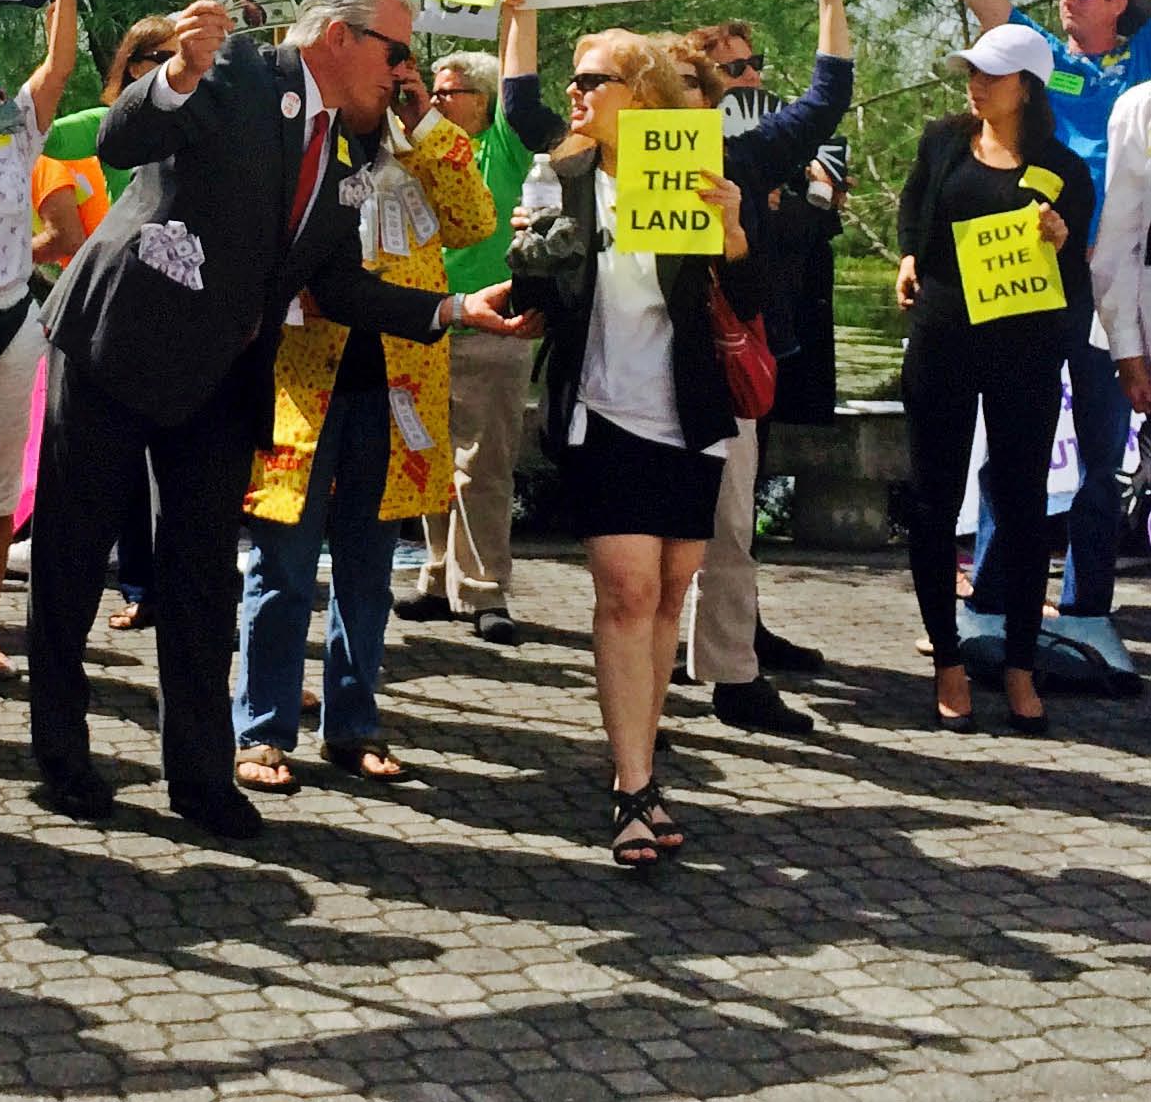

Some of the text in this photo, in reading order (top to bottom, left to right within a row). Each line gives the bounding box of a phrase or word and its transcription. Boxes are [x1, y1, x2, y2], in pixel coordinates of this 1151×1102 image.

[644, 130, 699, 151] BUY
[643, 170, 700, 191] THE
[631, 210, 710, 231] LAND
[977, 221, 1027, 247] BUY
[981, 247, 1033, 272] THE
[978, 276, 1048, 303] LAND
